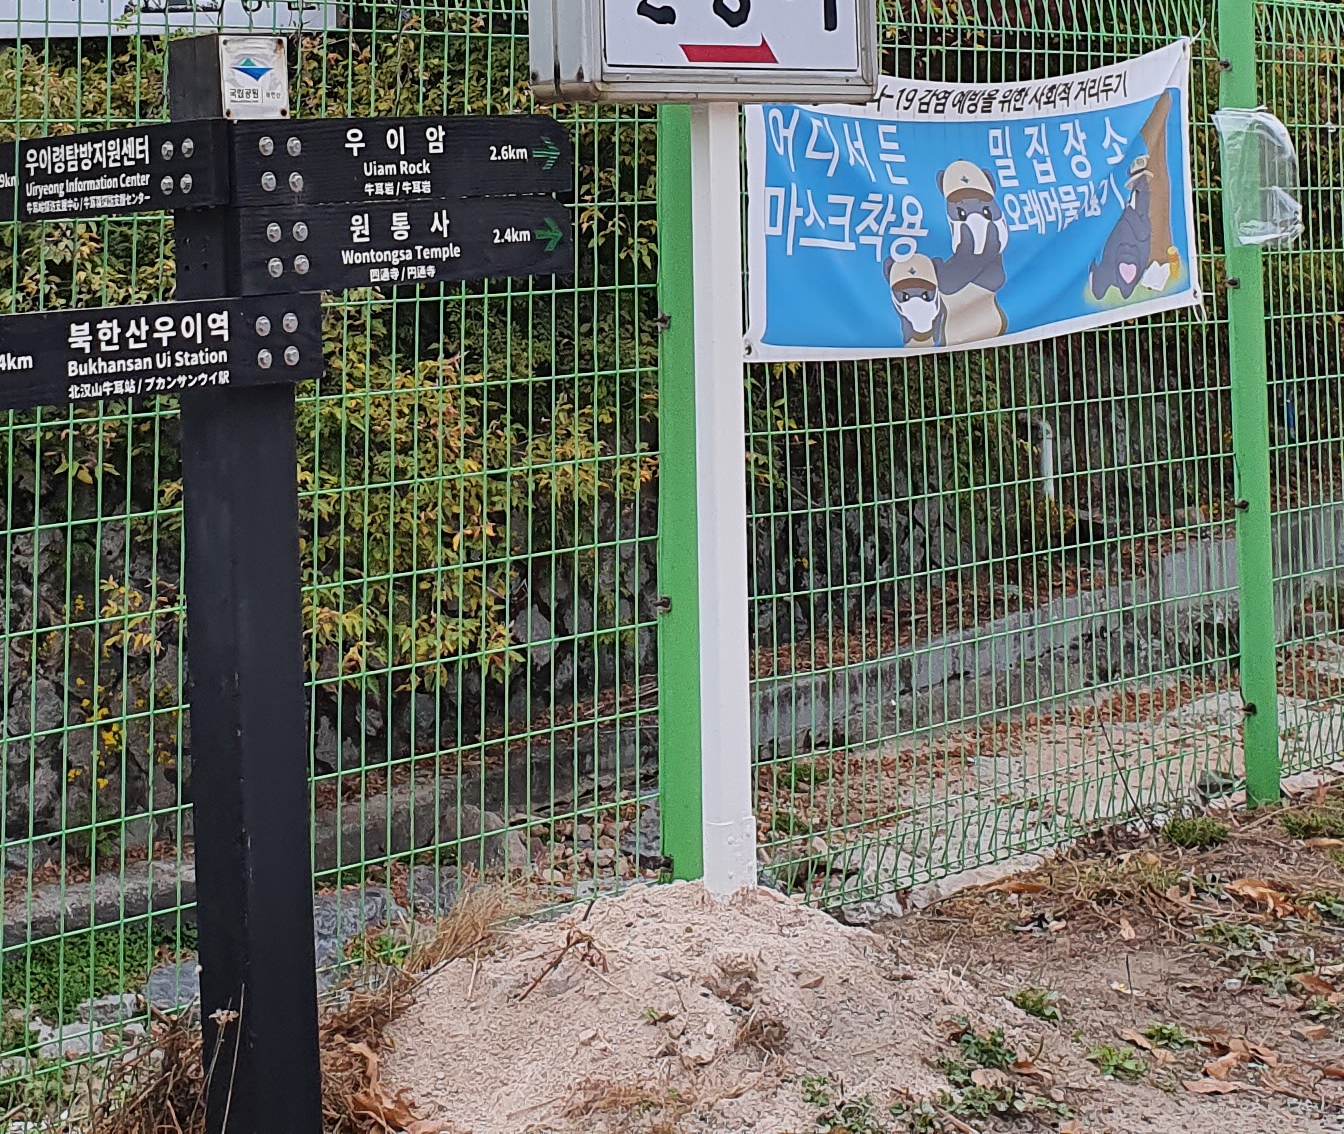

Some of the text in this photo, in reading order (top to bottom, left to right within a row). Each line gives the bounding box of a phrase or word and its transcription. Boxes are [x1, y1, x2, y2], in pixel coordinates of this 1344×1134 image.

[918, 88, 953, 114] 감염
[953, 87, 1000, 114] 예방을
[998, 86, 1031, 113] 위한
[1028, 79, 1075, 111] 사회적
[1074, 70, 1128, 106] 거리두기
[25, 134, 150, 177] 우이령탐방지원센터
[489, 144, 528, 161] 2.6km
[769, 108, 909, 185] 어디서든
[363, 159, 431, 177] Uiam Rock
[65, 174, 119, 194] Information
[119, 172, 151, 188] Center
[492, 228, 532, 244] 2.4km
[341, 243, 462, 266] Wontongsa Temple
[67, 310, 230, 354] 북한산우이역
[67, 355, 152, 377] Bukhansan
[156, 354, 172, 373] Ui
[174, 348, 228, 369] Station
